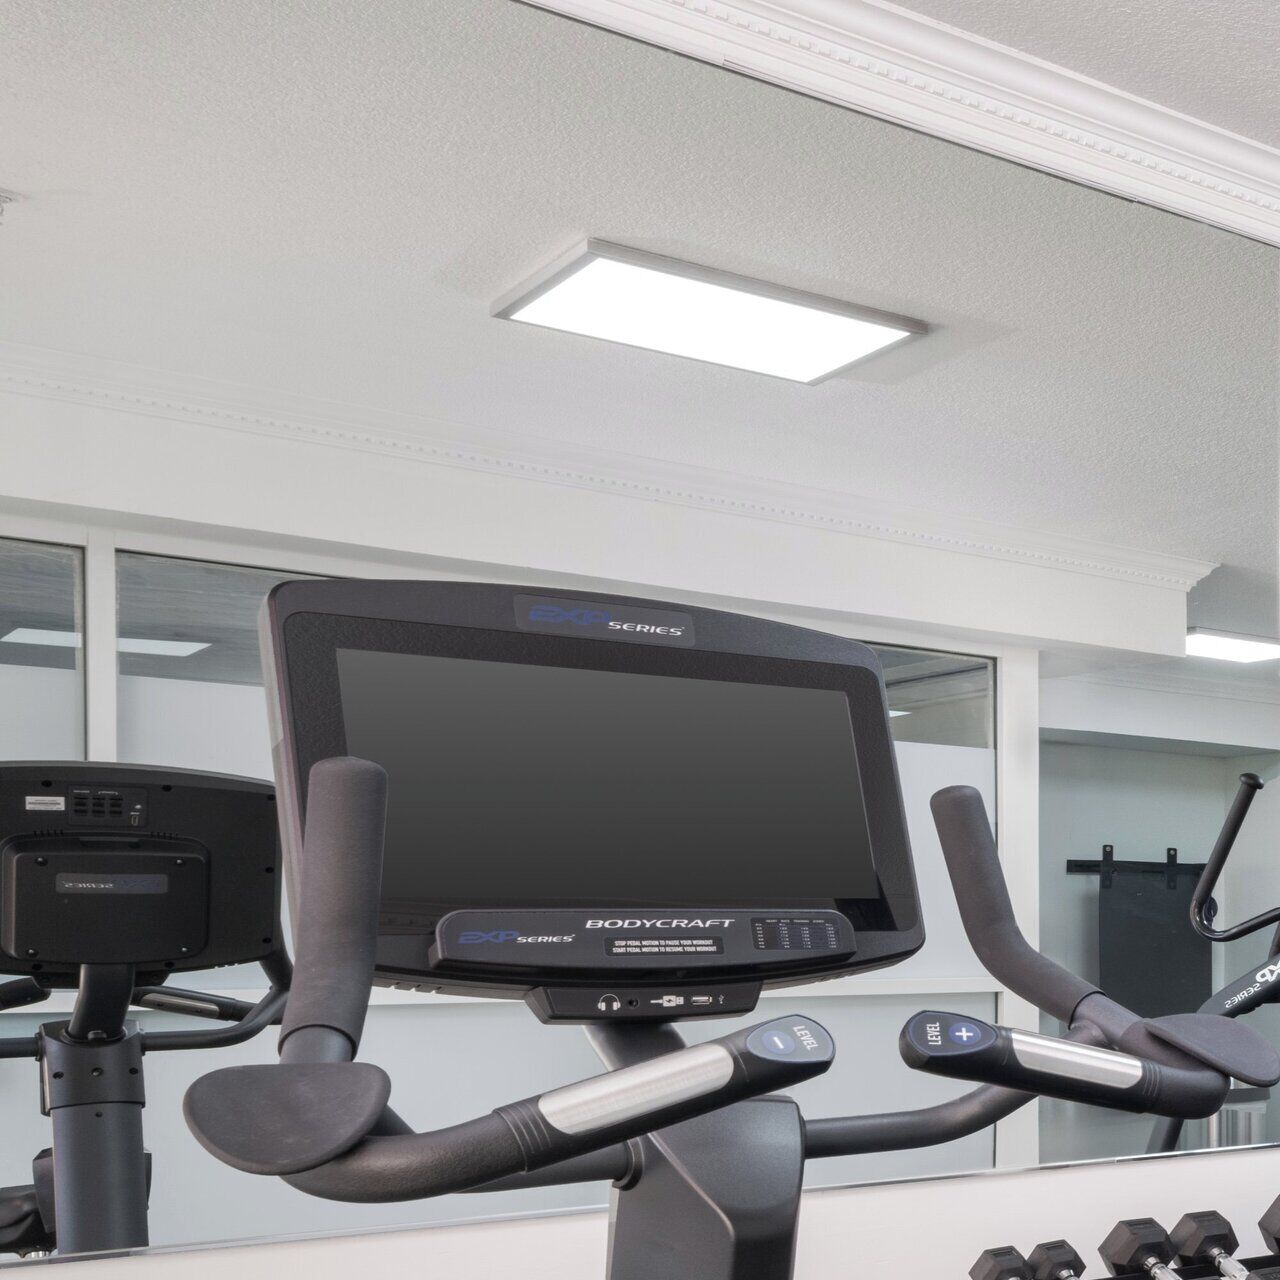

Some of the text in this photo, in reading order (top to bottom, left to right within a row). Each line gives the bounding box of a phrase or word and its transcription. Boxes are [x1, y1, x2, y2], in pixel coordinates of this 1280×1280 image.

[608, 621, 683, 637] SERIES
[585, 919, 736, 929] BODYCRAFT
[458, 930, 574, 944] EXP SERIES
[793, 1025, 819, 1051] LEVEL
[928, 1021, 942, 1046] LEVEL
